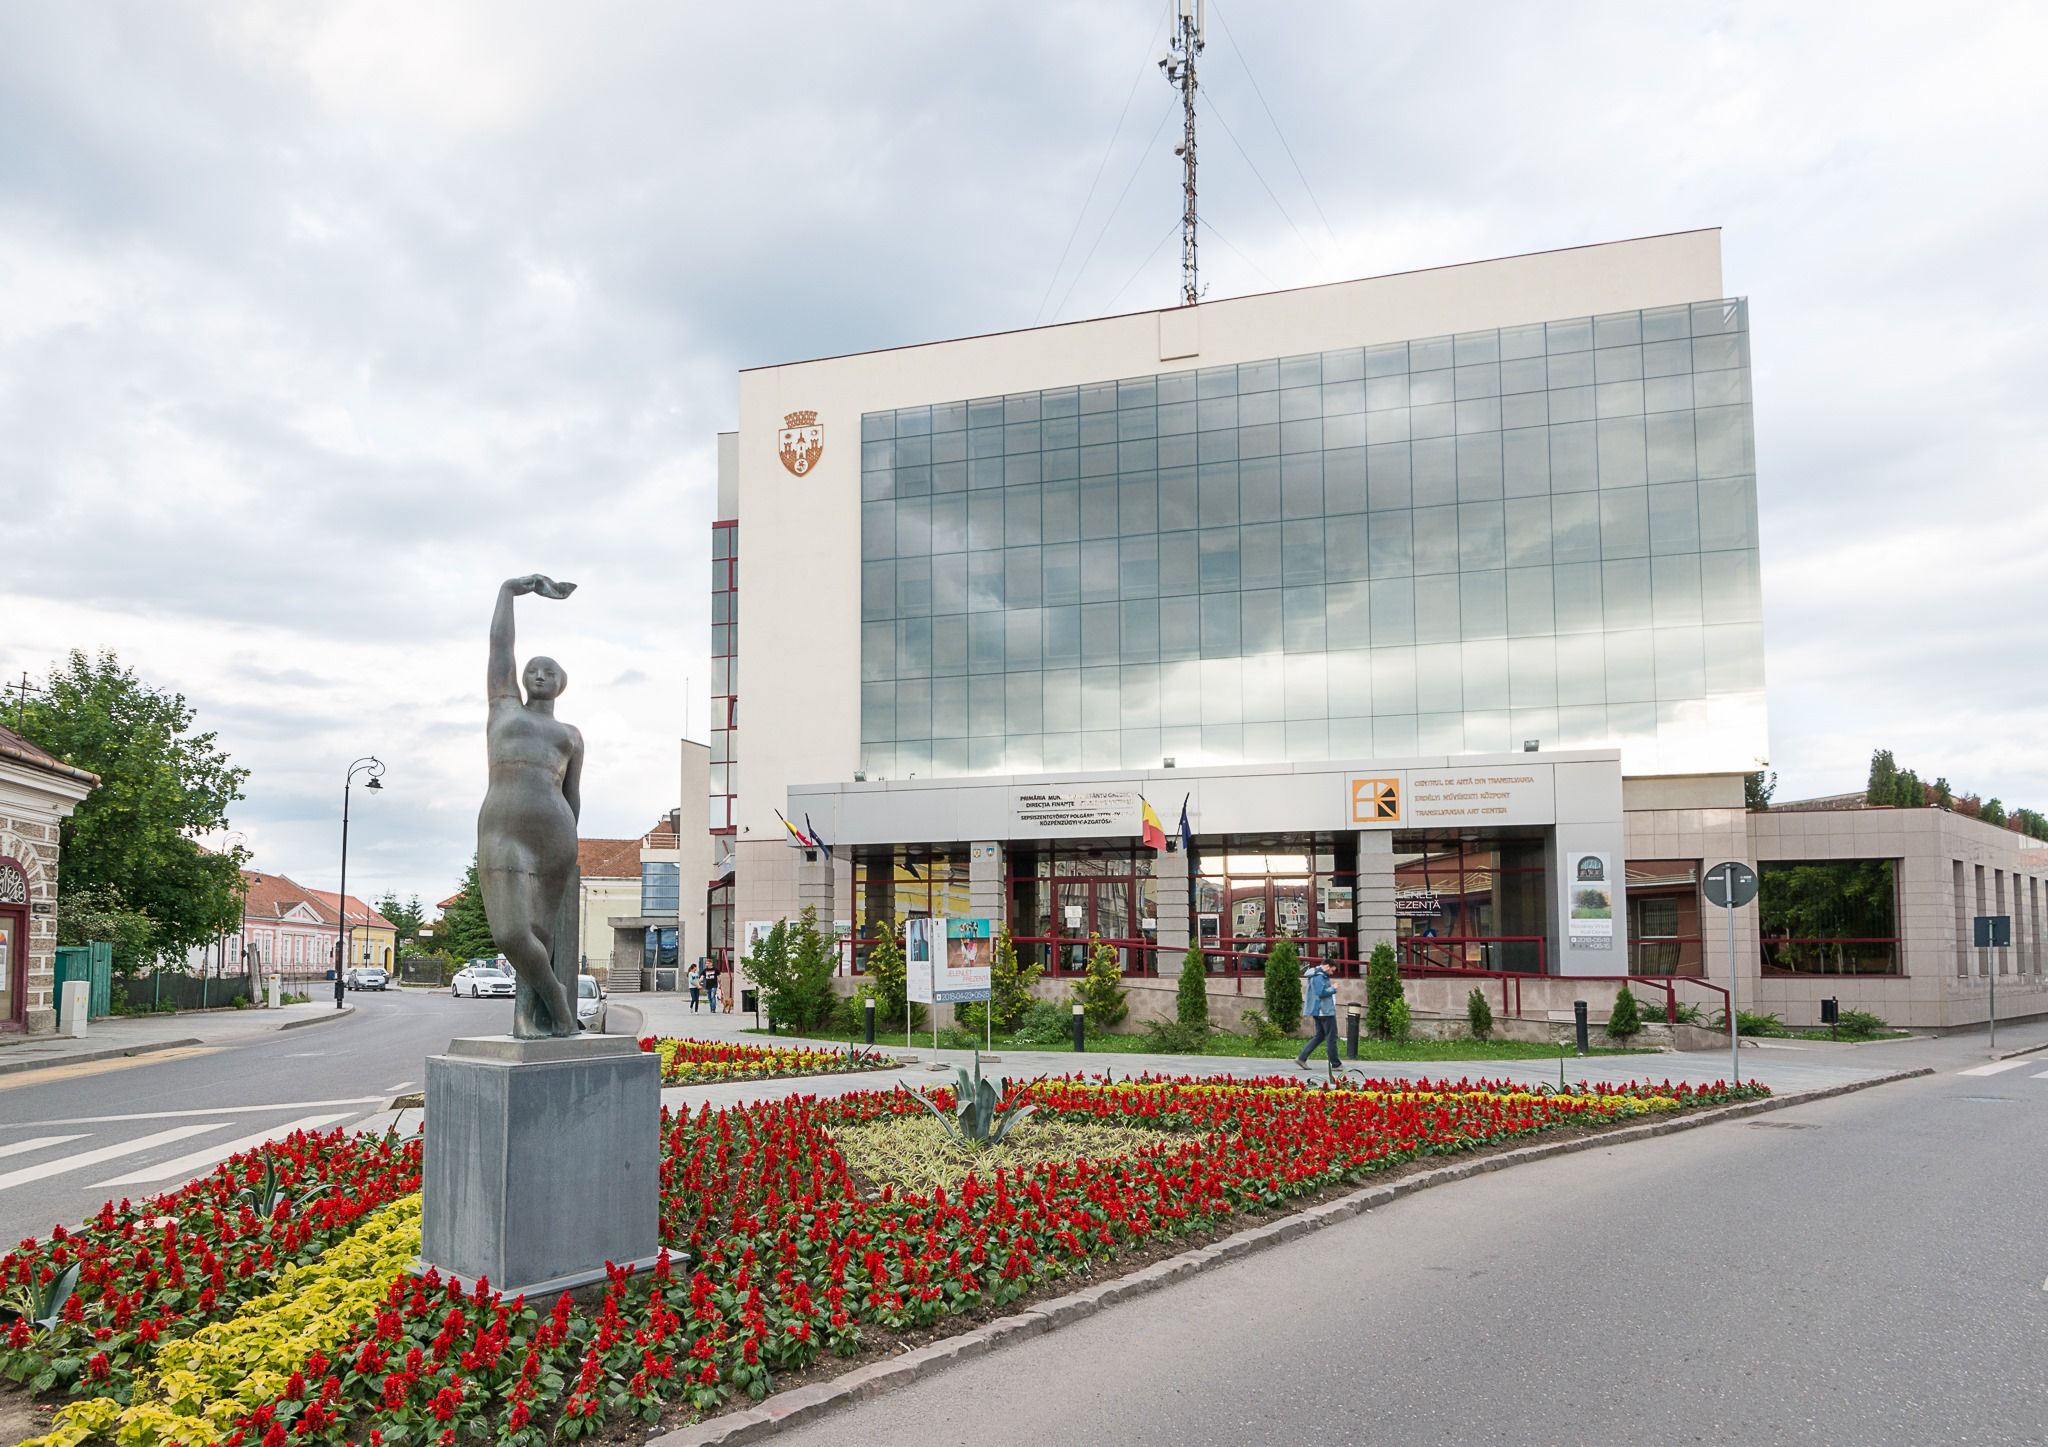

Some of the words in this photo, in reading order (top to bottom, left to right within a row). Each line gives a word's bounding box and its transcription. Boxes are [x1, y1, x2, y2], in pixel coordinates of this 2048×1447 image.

[1487, 776, 1535, 784] TRANSILVANIA
[1414, 793, 1441, 801] ERDÉLYI
[1480, 792, 1511, 800] KÖZPONT
[1415, 808, 1465, 816] TRANSILVANIAN
[1394, 900, 1440, 910] REZENȚĂ
